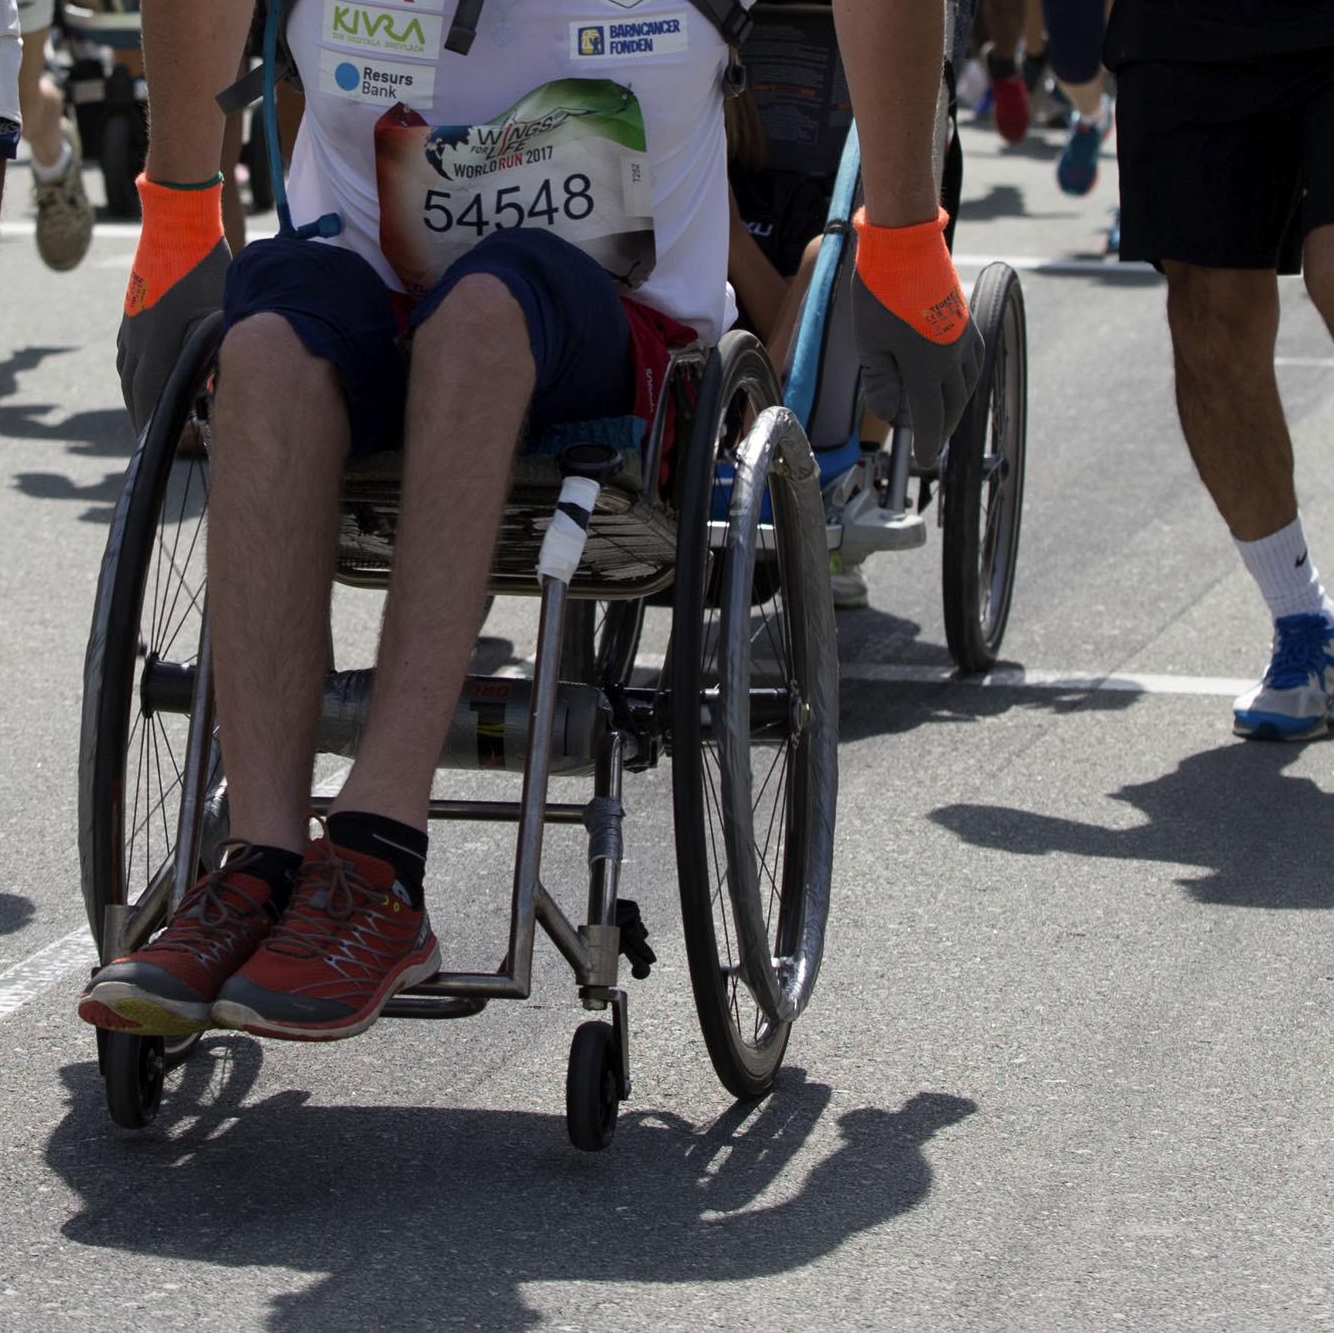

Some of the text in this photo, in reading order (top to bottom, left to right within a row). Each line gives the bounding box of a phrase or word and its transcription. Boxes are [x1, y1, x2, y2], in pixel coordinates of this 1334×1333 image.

[333, 5, 426, 46] KIVRA
[610, 18, 681, 38] BARNCANCER
[610, 39, 654, 55] FONDEN
[363, 66, 414, 86] Resurs
[362, 81, 398, 99] Bank
[477, 117, 553, 146] WINGS
[470, 137, 531, 160] FOR LIFE
[453, 145, 554, 179] WORLD RUN 2017
[423, 173, 595, 237] 54548
